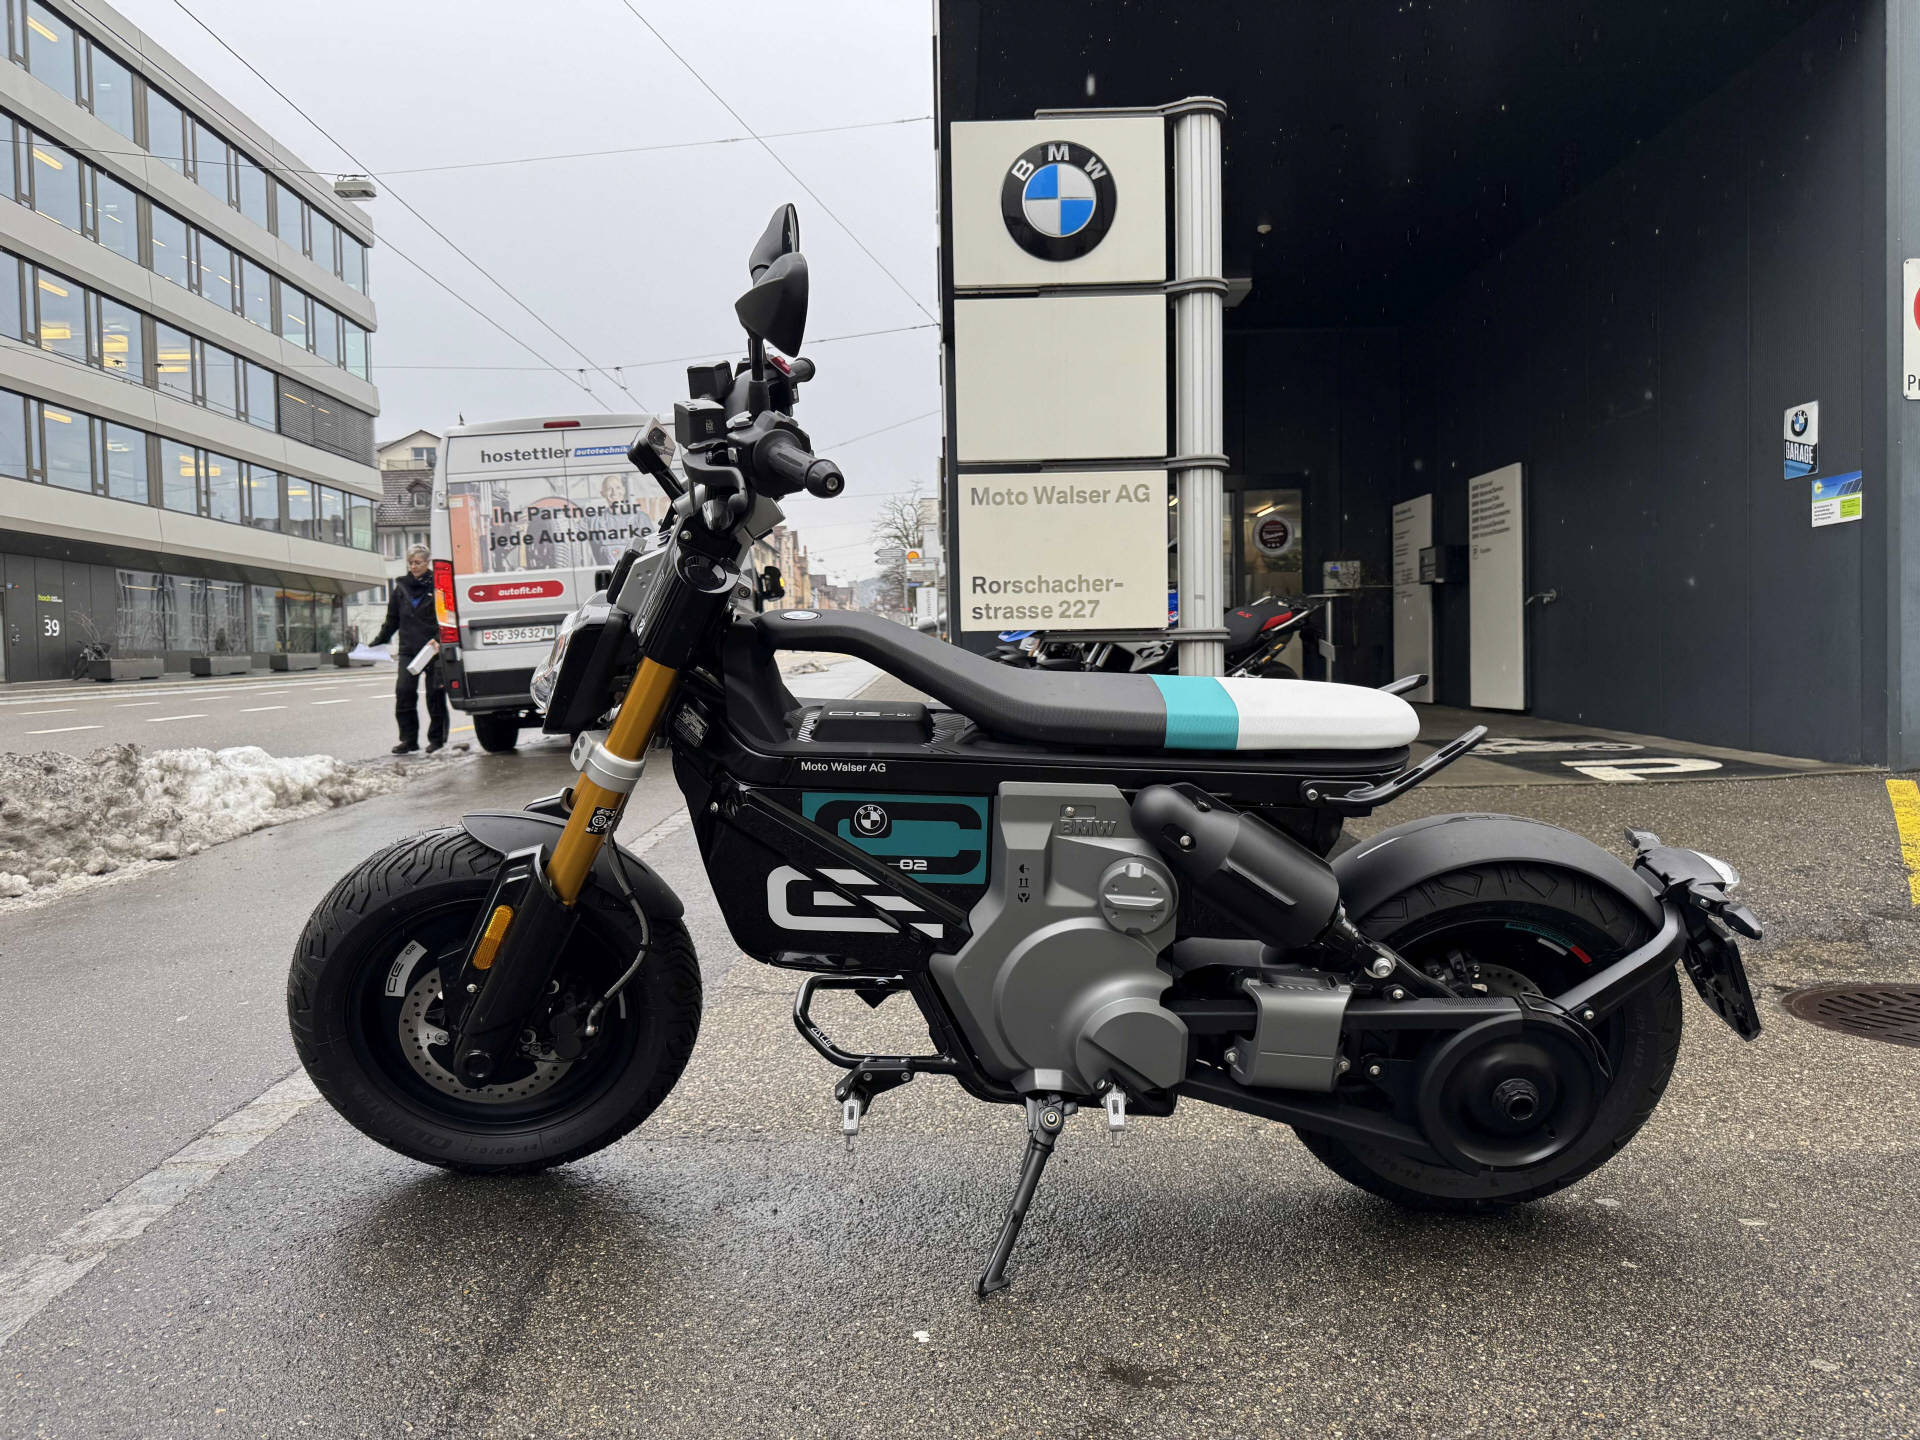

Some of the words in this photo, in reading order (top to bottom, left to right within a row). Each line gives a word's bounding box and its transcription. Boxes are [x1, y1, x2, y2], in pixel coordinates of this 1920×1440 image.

[1011, 143, 1107, 182] BMW
[481, 447, 571, 463] hostettler
[576, 446, 629, 456] autotechnik
[1785, 441, 1814, 465] GARAGE
[970, 487, 1028, 506] Moto
[1033, 485, 1111, 505] Walser
[1115, 483, 1151, 503] AG
[493, 507, 522, 524] Ihr
[527, 502, 606, 521] Partner
[609, 500, 641, 516] für
[490, 531, 534, 551] jede
[538, 524, 651, 545] Automarke
[498, 585, 543, 597] autofit.ch
[971, 574, 1124, 594] Rorschacher-
[971, 603, 1054, 620] strasse
[1058, 600, 1101, 619] 227
[44, 618, 60, 637] 39
[801, 761, 829, 771] Moto
[830, 762, 867, 772] Walser
[869, 763, 887, 773] AG
[1060, 819, 1118, 837] BMW
